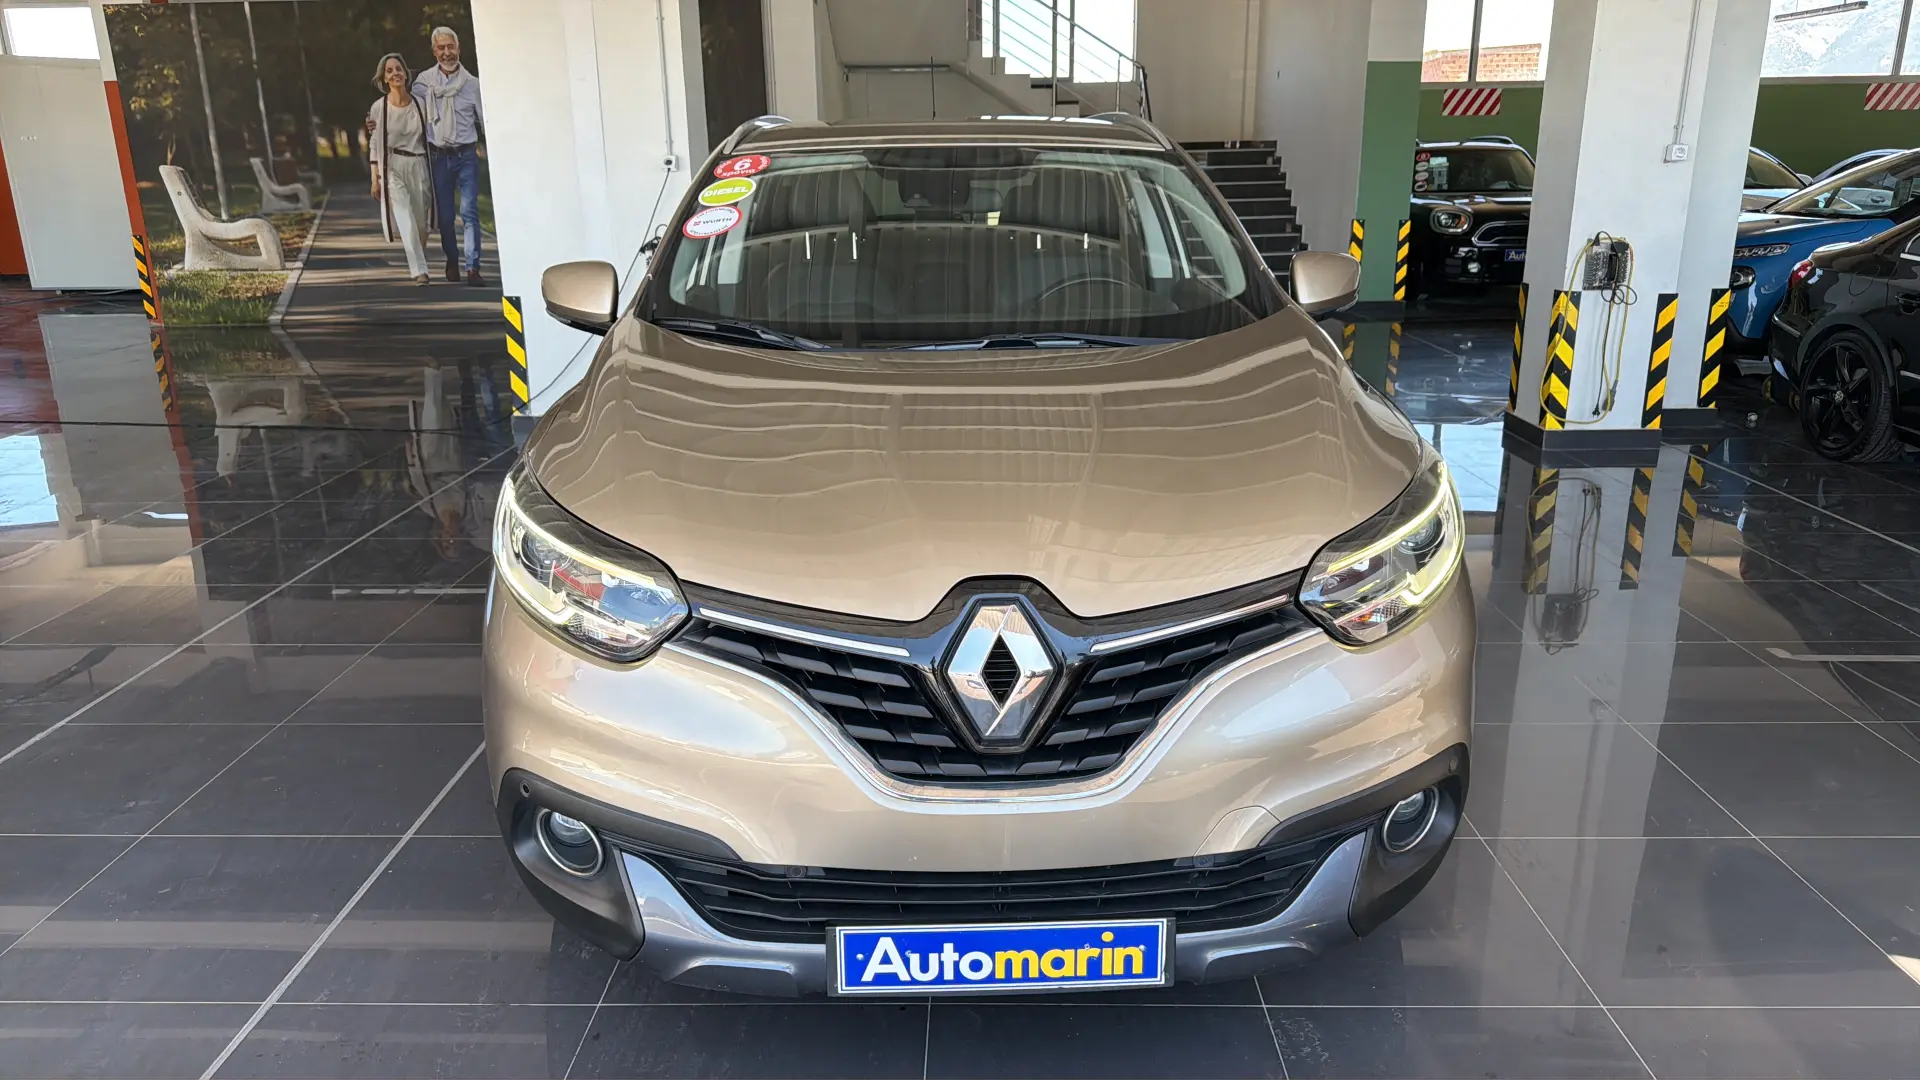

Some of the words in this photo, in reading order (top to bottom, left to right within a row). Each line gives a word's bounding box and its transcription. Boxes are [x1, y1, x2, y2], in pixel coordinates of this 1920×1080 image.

[734, 158, 752, 170] 6
[704, 186, 749, 198] DIESEL
[861, 931, 1143, 982] Automarin
